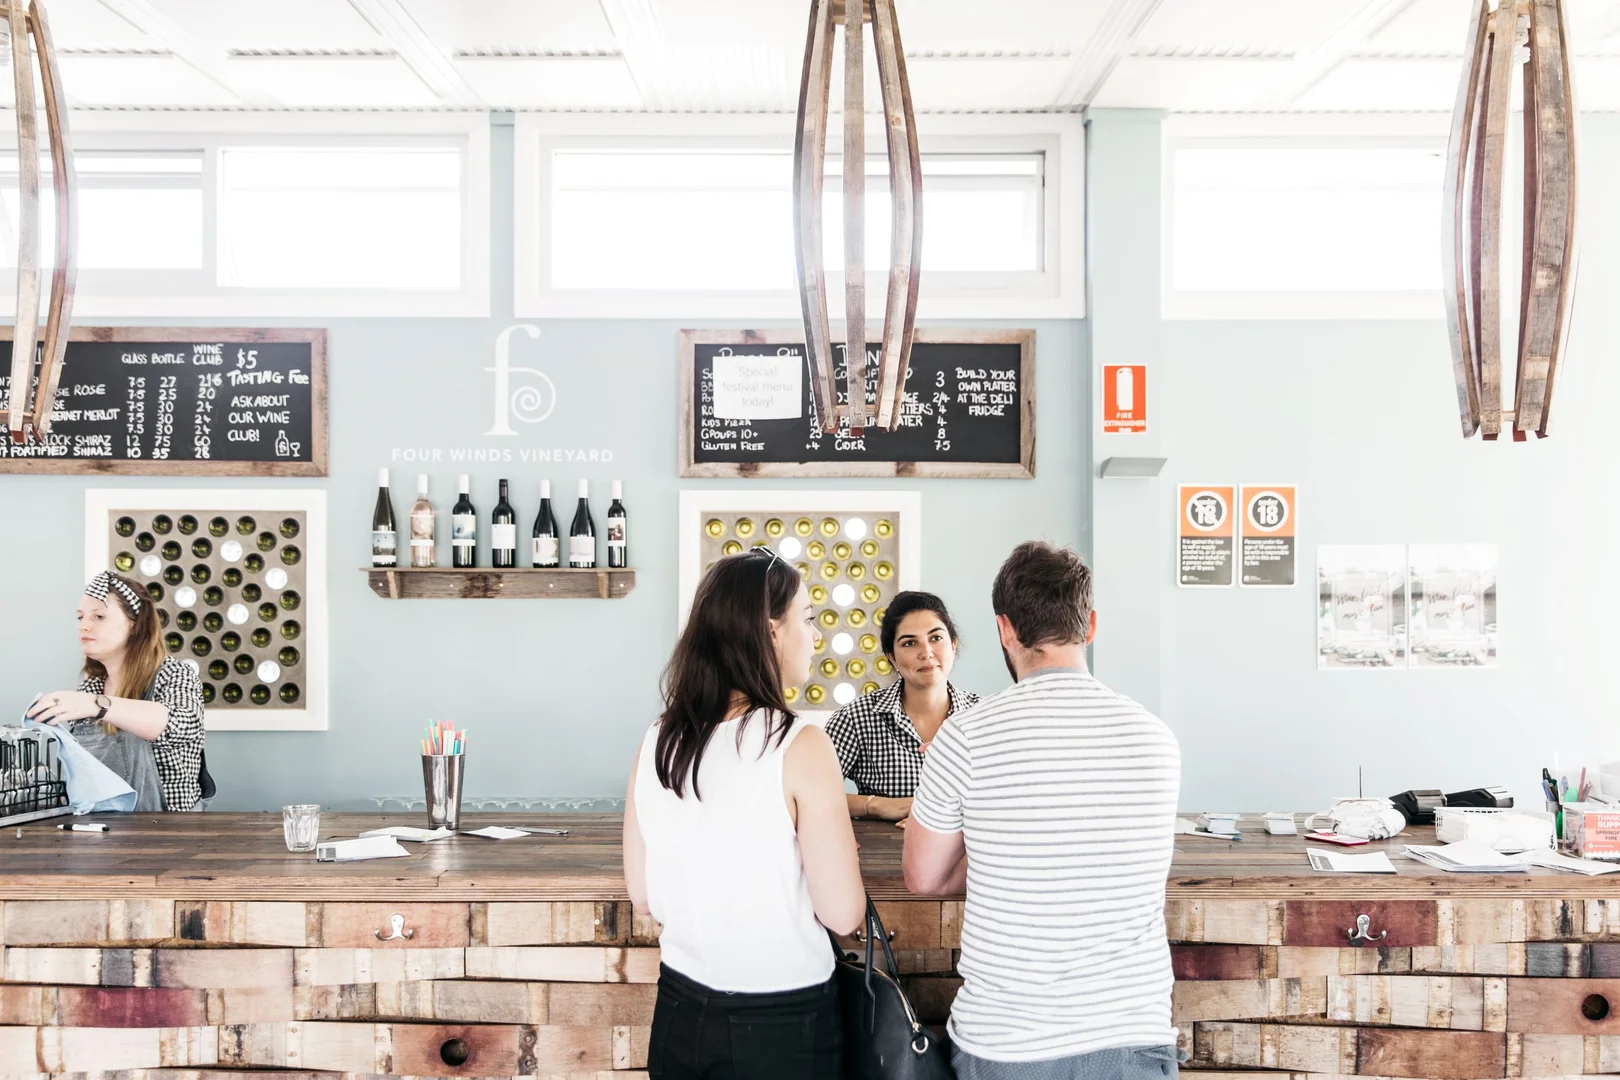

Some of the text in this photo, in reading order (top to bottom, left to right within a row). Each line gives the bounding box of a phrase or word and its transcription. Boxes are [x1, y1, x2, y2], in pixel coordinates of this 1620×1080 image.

[193, 344, 224, 354] WINE
[122, 354, 148, 364] GLASS
[192, 354, 224, 365] CLUB
[236, 348, 258, 369] $5
[738, 366, 777, 379] Special
[955, 367, 1016, 380] BUILD YOUR
[160, 376, 177, 388] 27
[936, 370, 945, 388] 3
[74, 384, 106, 396] ROSE
[722, 382, 794, 392] festival menu
[958, 381, 1016, 392] OWN PLATTER
[158, 388, 177, 400] 25
[198, 388, 216, 400] 20
[932, 392, 950, 406] 2/4
[957, 394, 1013, 404] AT THE DELI
[158, 400, 174, 413] 30
[196, 400, 213, 412] 24
[231, 394, 290, 408] ASK ABOUT
[742, 396, 774, 408] today!
[83, 408, 120, 422] MERLOT
[938, 405, 947, 414] 4
[968, 406, 1004, 416] FRIDGE
[157, 413, 174, 424] 30
[194, 414, 212, 424] 24
[228, 410, 290, 424] OUR WINE
[701, 418, 720, 428] KIDS
[937, 416, 947, 426] 4
[156, 424, 174, 435] 30
[194, 424, 211, 435] 24
[228, 429, 260, 442] CLUB!
[741, 429, 758, 440] 10+
[938, 428, 946, 439] 8
[74, 434, 112, 446] SHIRAZ
[126, 435, 211, 447] 12 75 60
[701, 441, 737, 451] GLUTEN
[740, 441, 765, 451] FREE
[835, 440, 866, 451] CIDER
[10, 446, 68, 458] FORTIFIED
[73, 446, 112, 457] SHIRAZ
[126, 446, 210, 459] 10 35 28
[392, 448, 614, 462] FOUR WINDS VINEYARD
[1258, 505, 1278, 524] 18
